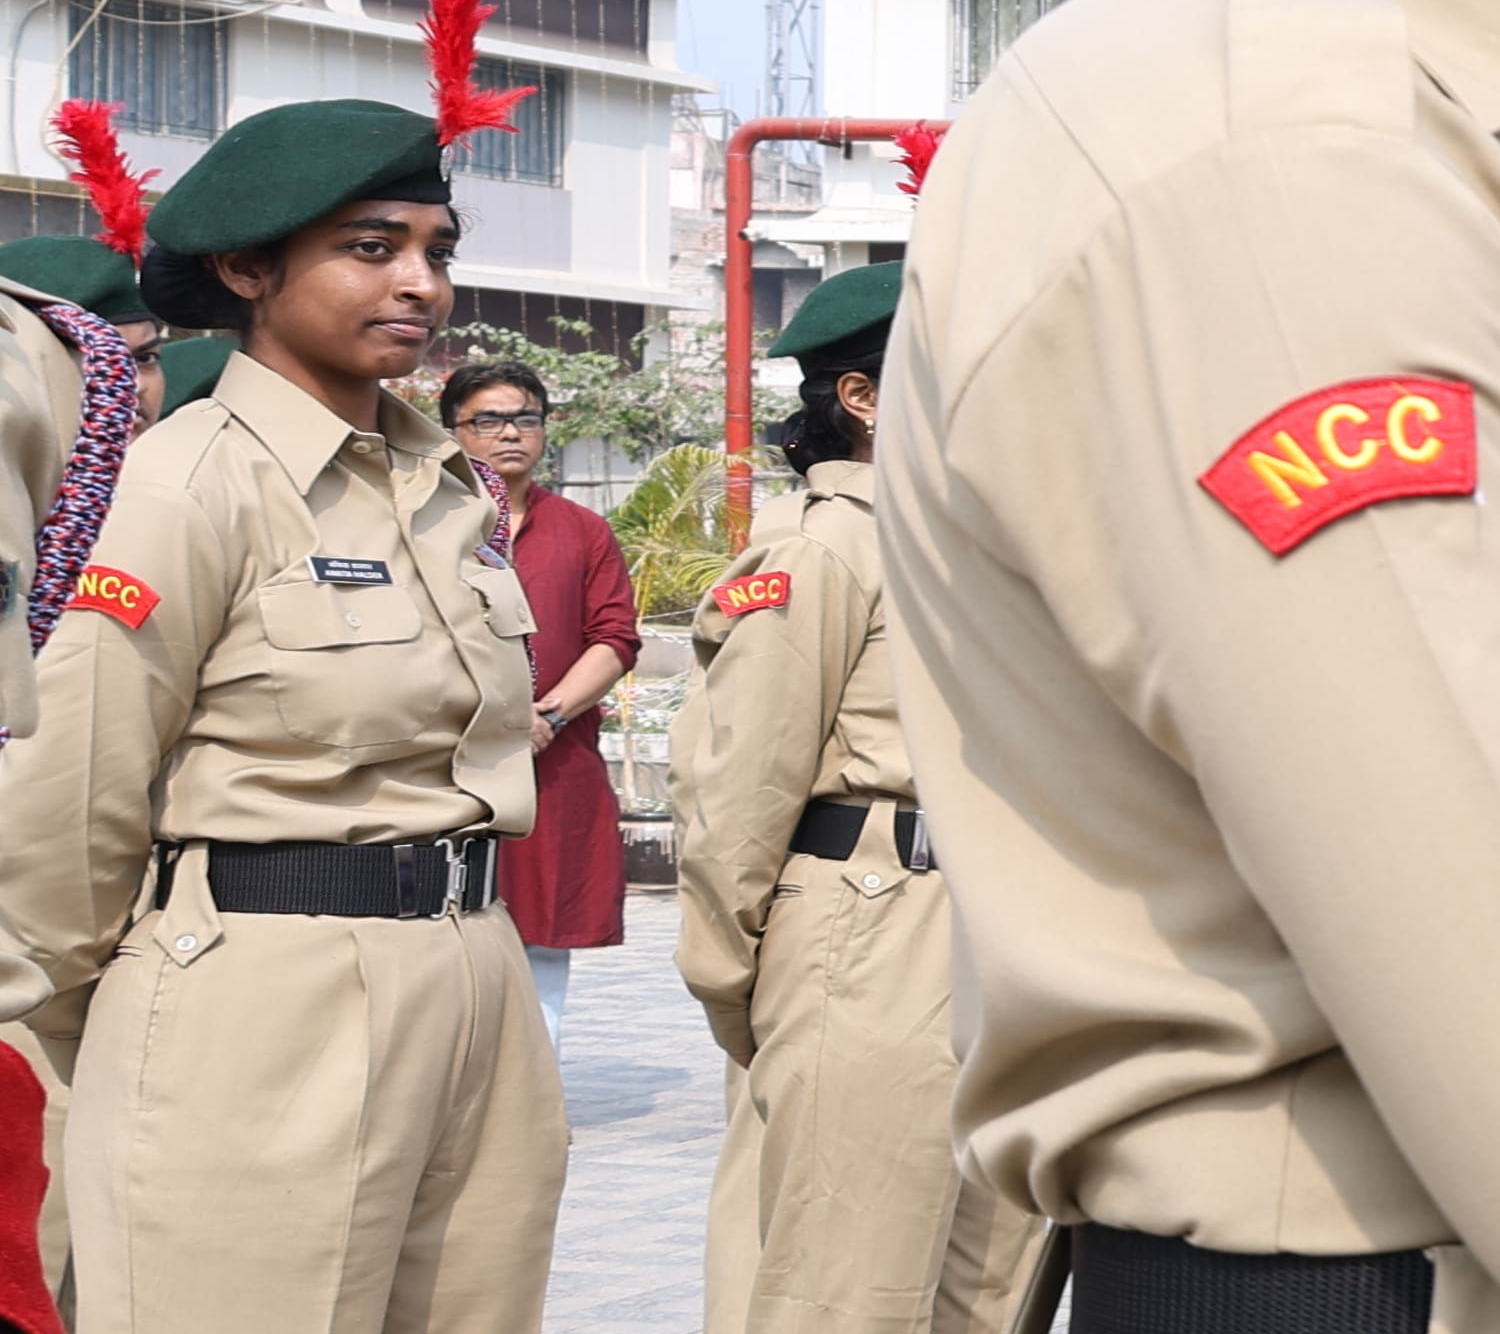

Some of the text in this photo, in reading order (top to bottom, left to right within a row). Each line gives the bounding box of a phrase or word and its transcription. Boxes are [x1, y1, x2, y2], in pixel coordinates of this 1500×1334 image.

[1248, 395, 1443, 509] NCC
[78, 572, 141, 608] NCC
[727, 578, 781, 607] NCC
